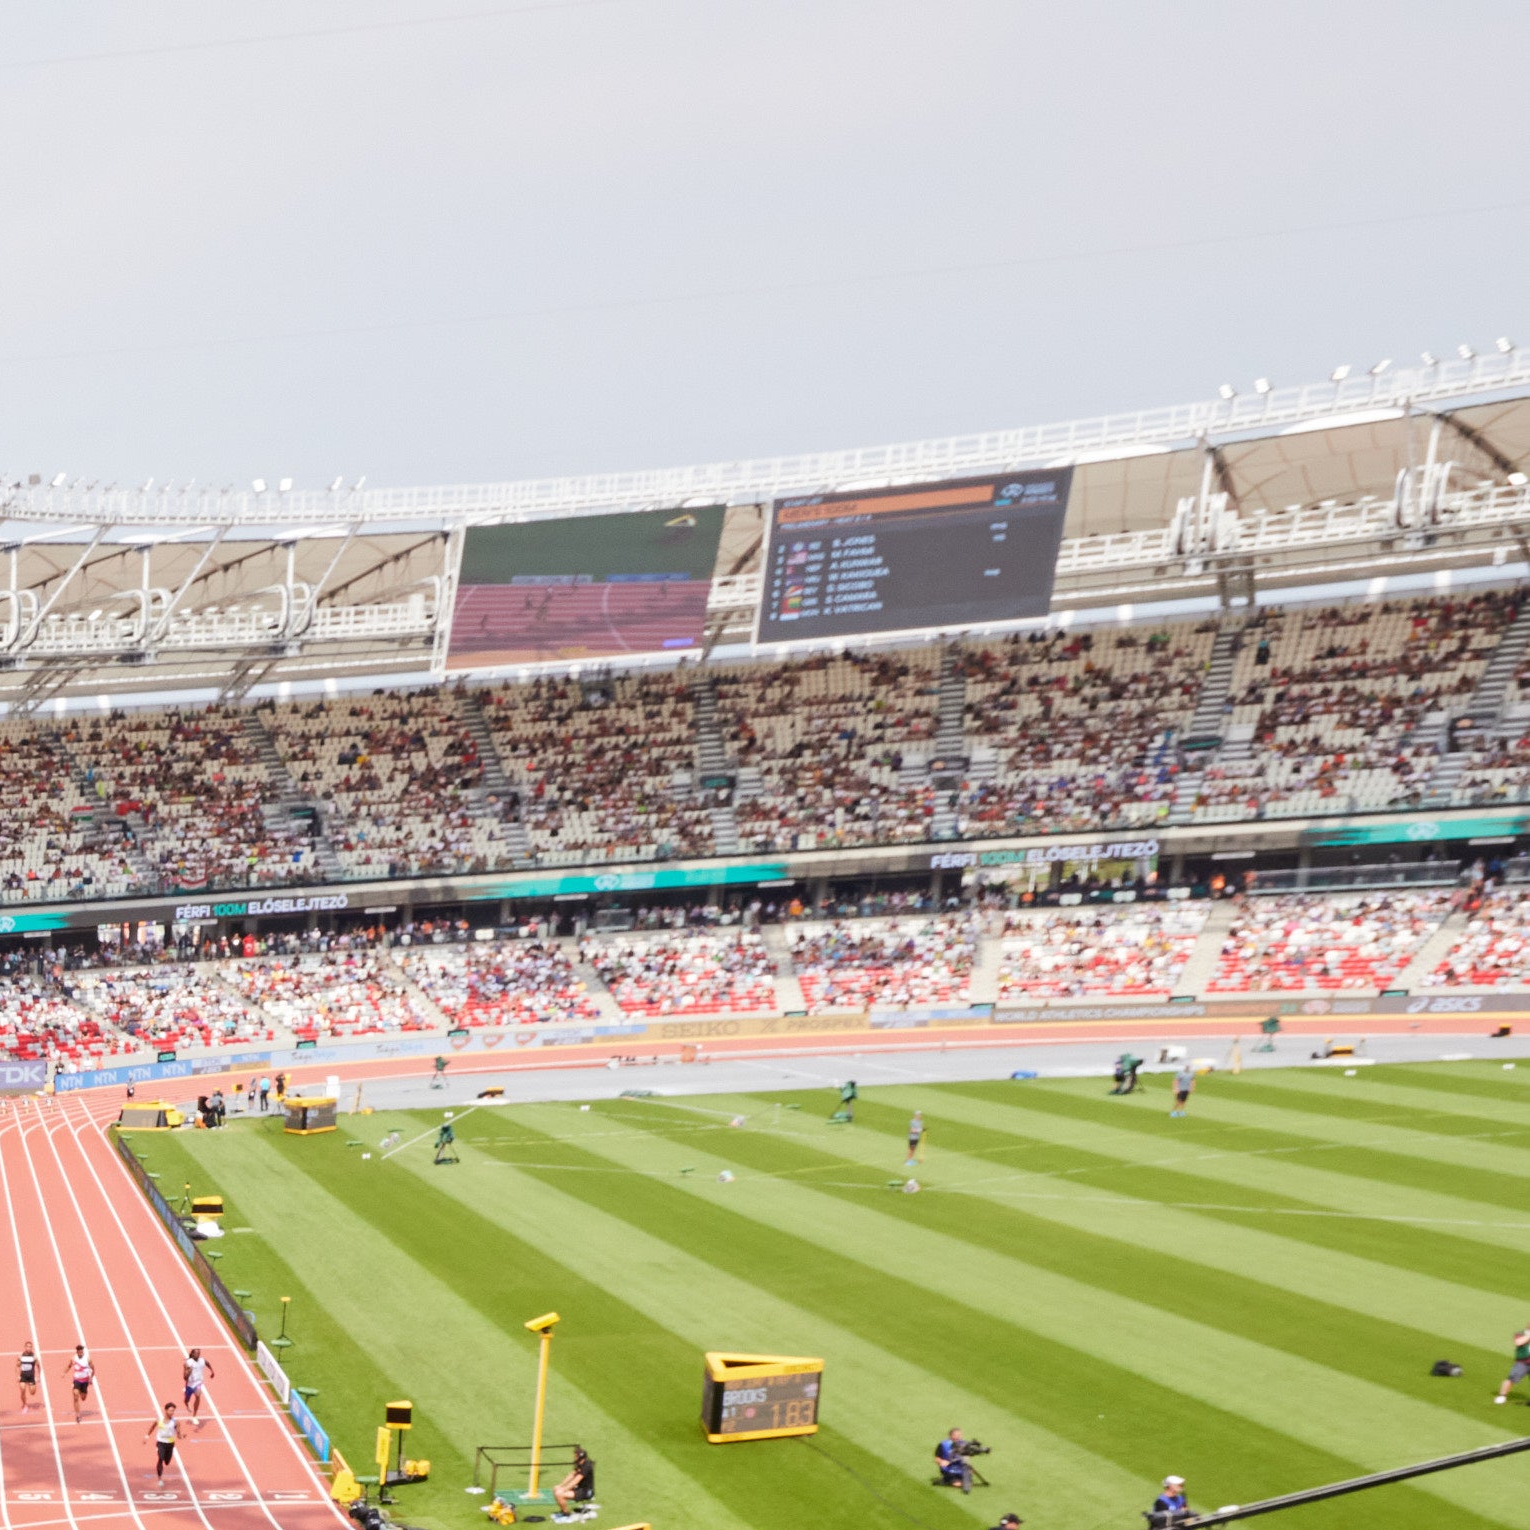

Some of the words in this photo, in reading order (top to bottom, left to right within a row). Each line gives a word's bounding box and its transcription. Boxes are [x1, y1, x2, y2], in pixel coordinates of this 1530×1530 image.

[176, 904, 210, 919] FÉRFI
[212, 903, 247, 917] 100M
[163, 1063, 186, 1077] NTN
[61, 1075, 83, 1090] NTN
[94, 1072, 118, 1086] NTN
